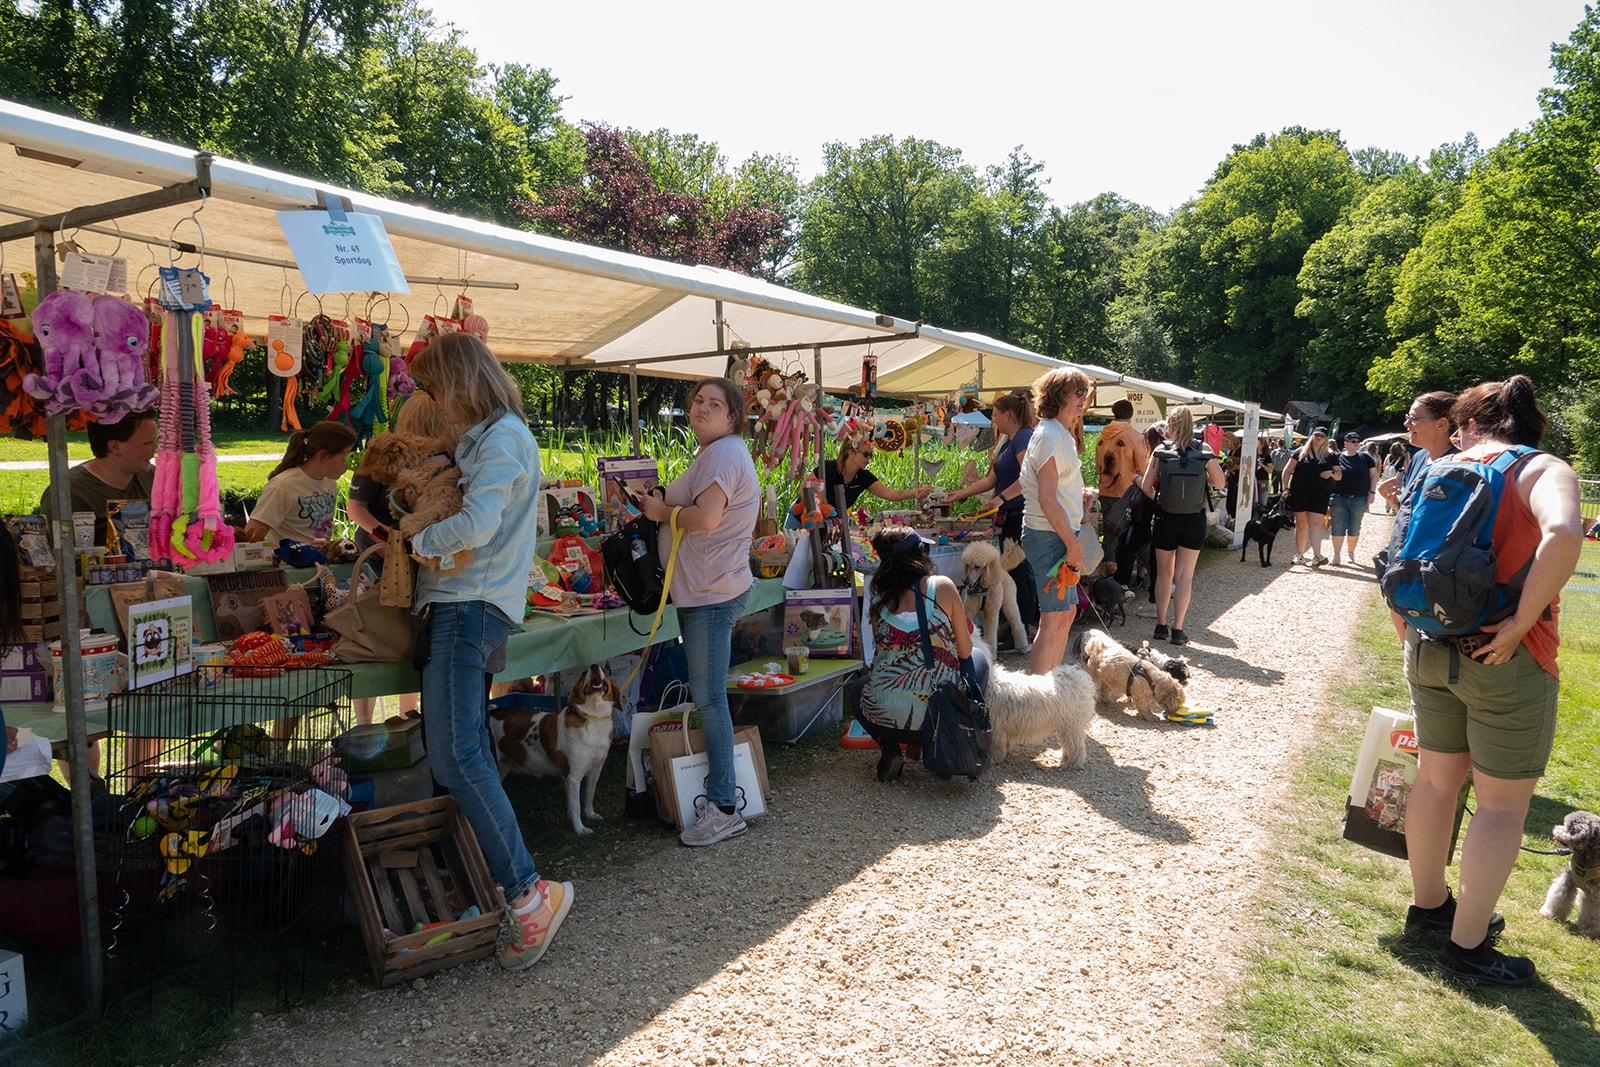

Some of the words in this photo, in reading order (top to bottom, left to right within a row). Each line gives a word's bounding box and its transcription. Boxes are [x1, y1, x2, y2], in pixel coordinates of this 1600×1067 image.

[335, 244, 349, 253] Nr.
[350, 245, 360, 253] 49
[334, 255, 372, 266] Sportdog
[1127, 393, 1144, 402] WOEF
[209, 570, 285, 593] GOLDENDOODLE
[1393, 734, 1418, 751] pa
